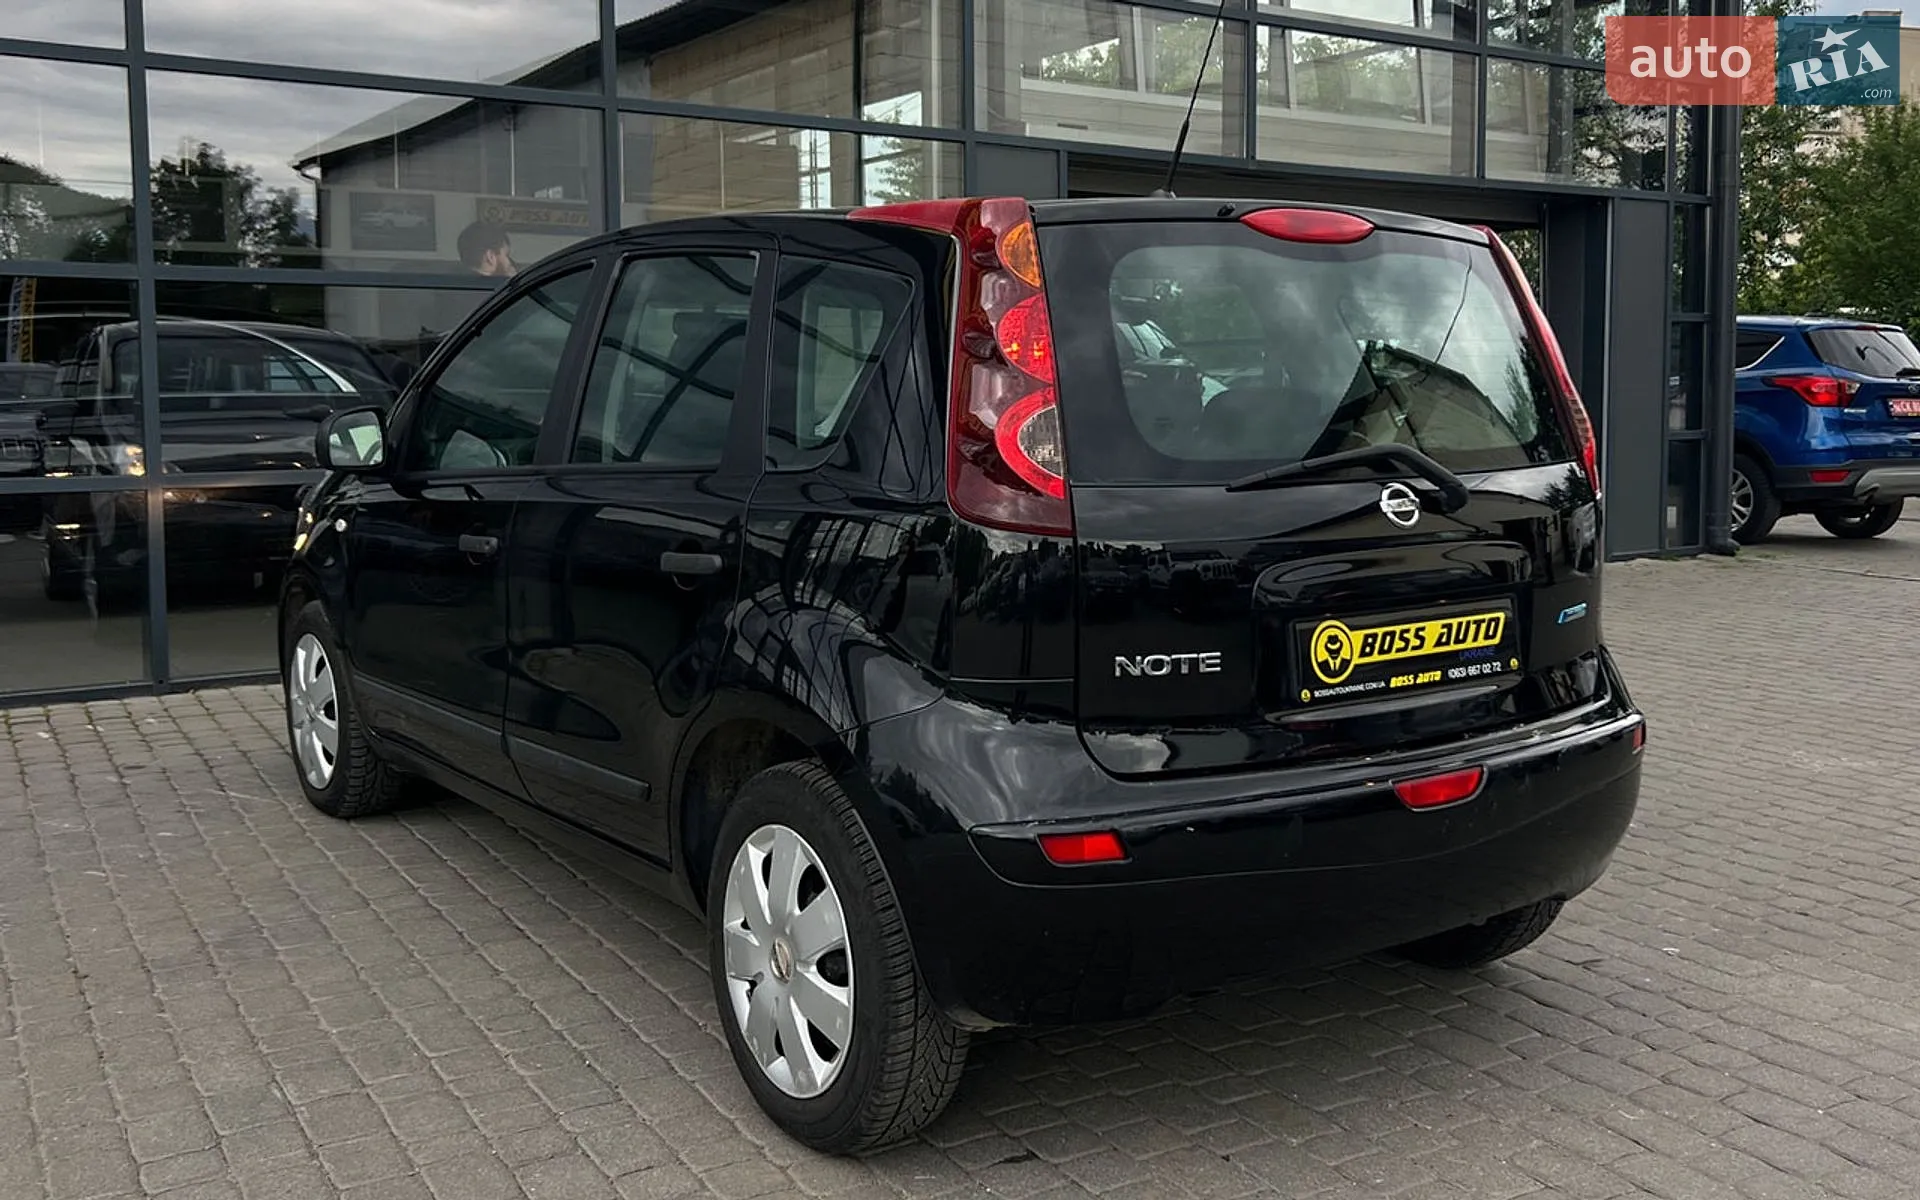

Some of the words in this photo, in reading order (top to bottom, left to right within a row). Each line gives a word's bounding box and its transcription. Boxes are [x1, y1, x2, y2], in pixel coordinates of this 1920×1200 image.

[1358, 626, 1427, 659] BOSS
[1433, 617, 1500, 647] AUTO
[1115, 652, 1222, 677] NOTE
[1389, 674, 1415, 689] BOSS
[1416, 670, 1442, 684] AUTO
